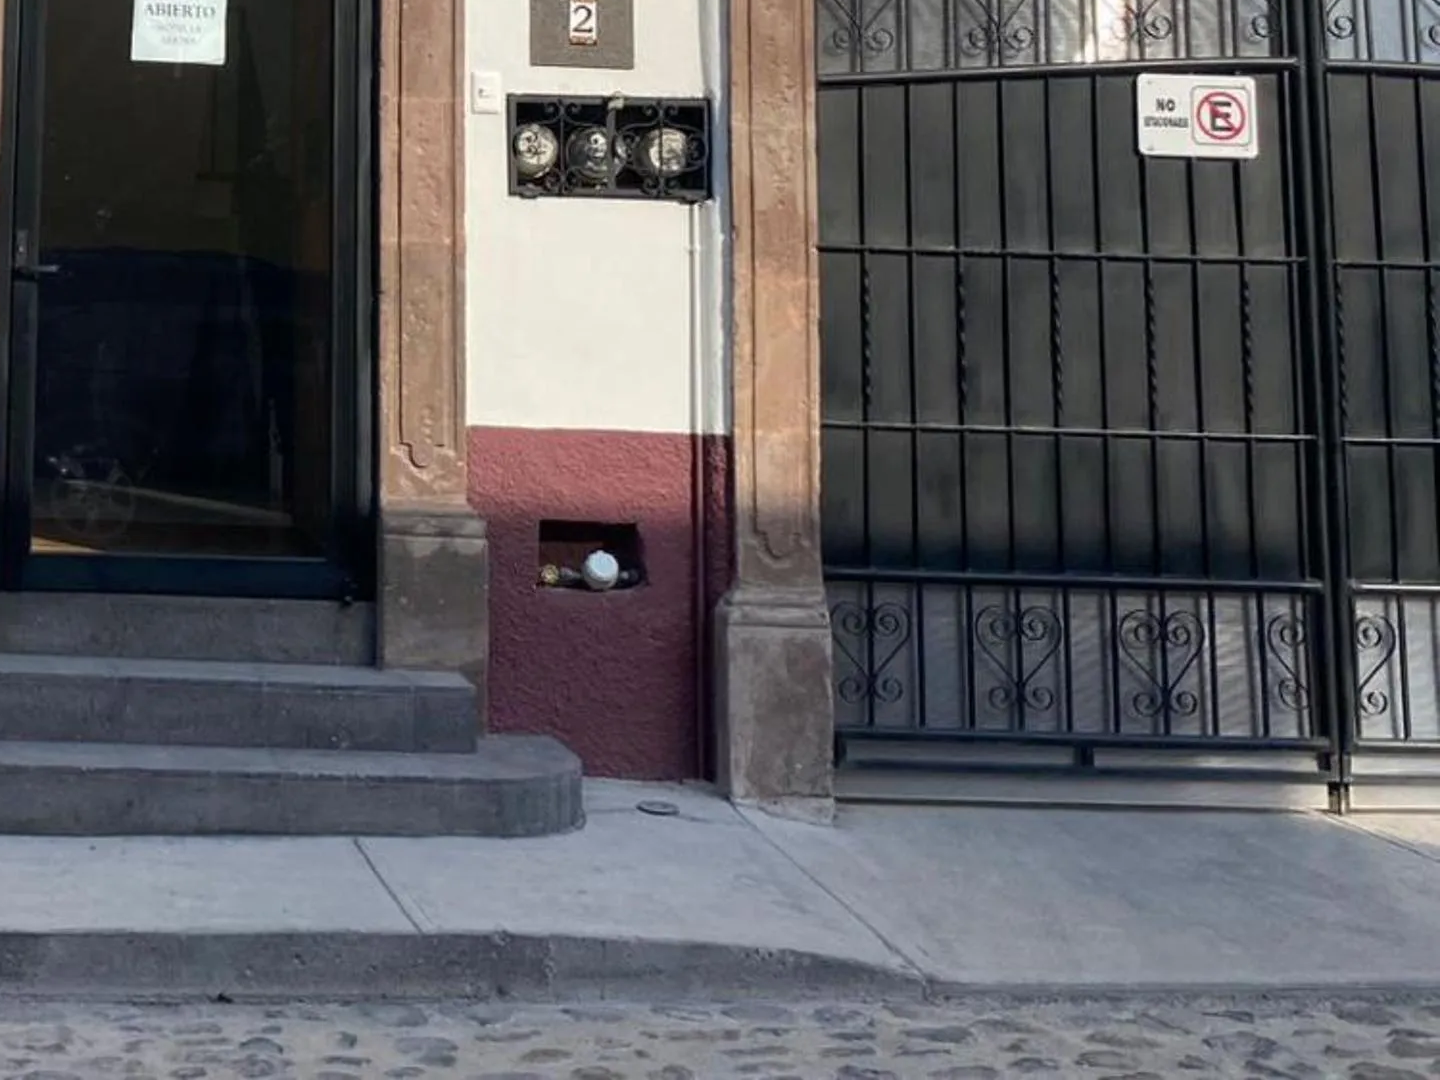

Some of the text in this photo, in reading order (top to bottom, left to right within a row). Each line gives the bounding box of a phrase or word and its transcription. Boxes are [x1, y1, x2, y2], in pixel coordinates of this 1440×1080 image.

[144, 3, 216, 19] ABIERTO
[572, 5, 593, 33] 2
[1155, 98, 1176, 112] NO
[1209, 100, 1233, 132] E
